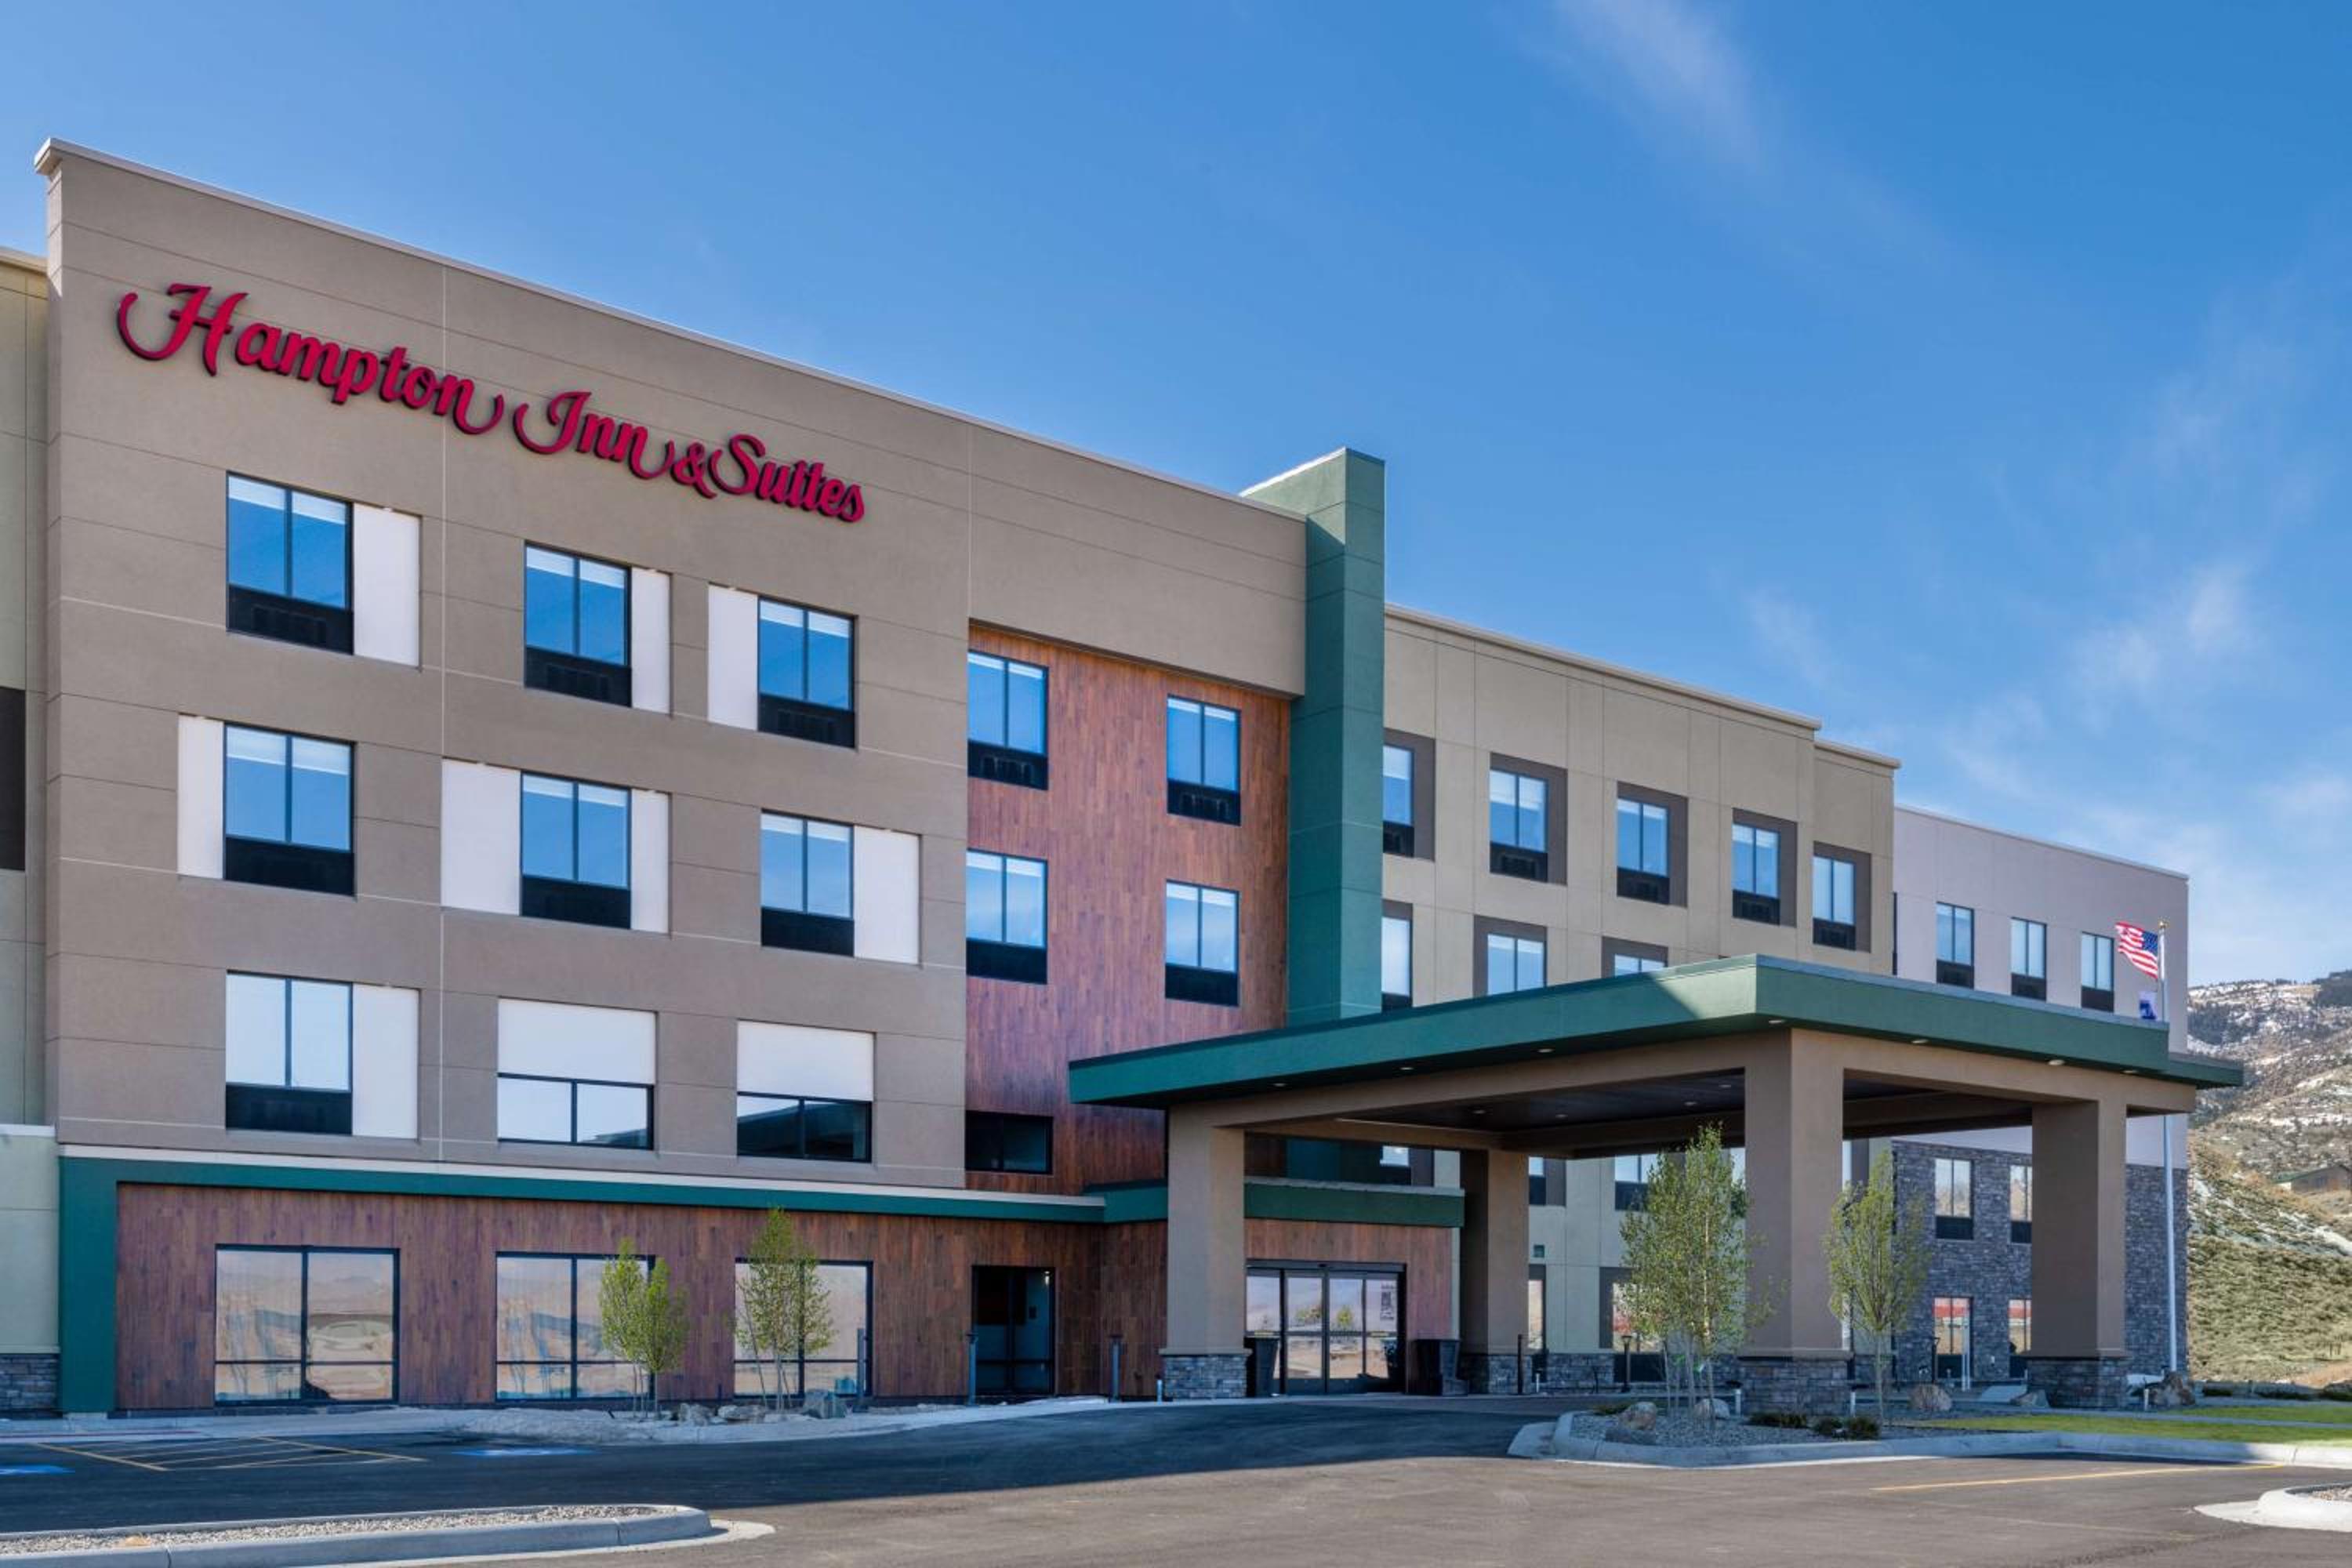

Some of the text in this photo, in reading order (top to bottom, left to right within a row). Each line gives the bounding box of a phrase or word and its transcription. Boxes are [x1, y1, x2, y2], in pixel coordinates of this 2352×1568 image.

[118, 281, 505, 435] Hampton
[514, 390, 675, 479] Inn
[708, 434, 866, 523] Suites
